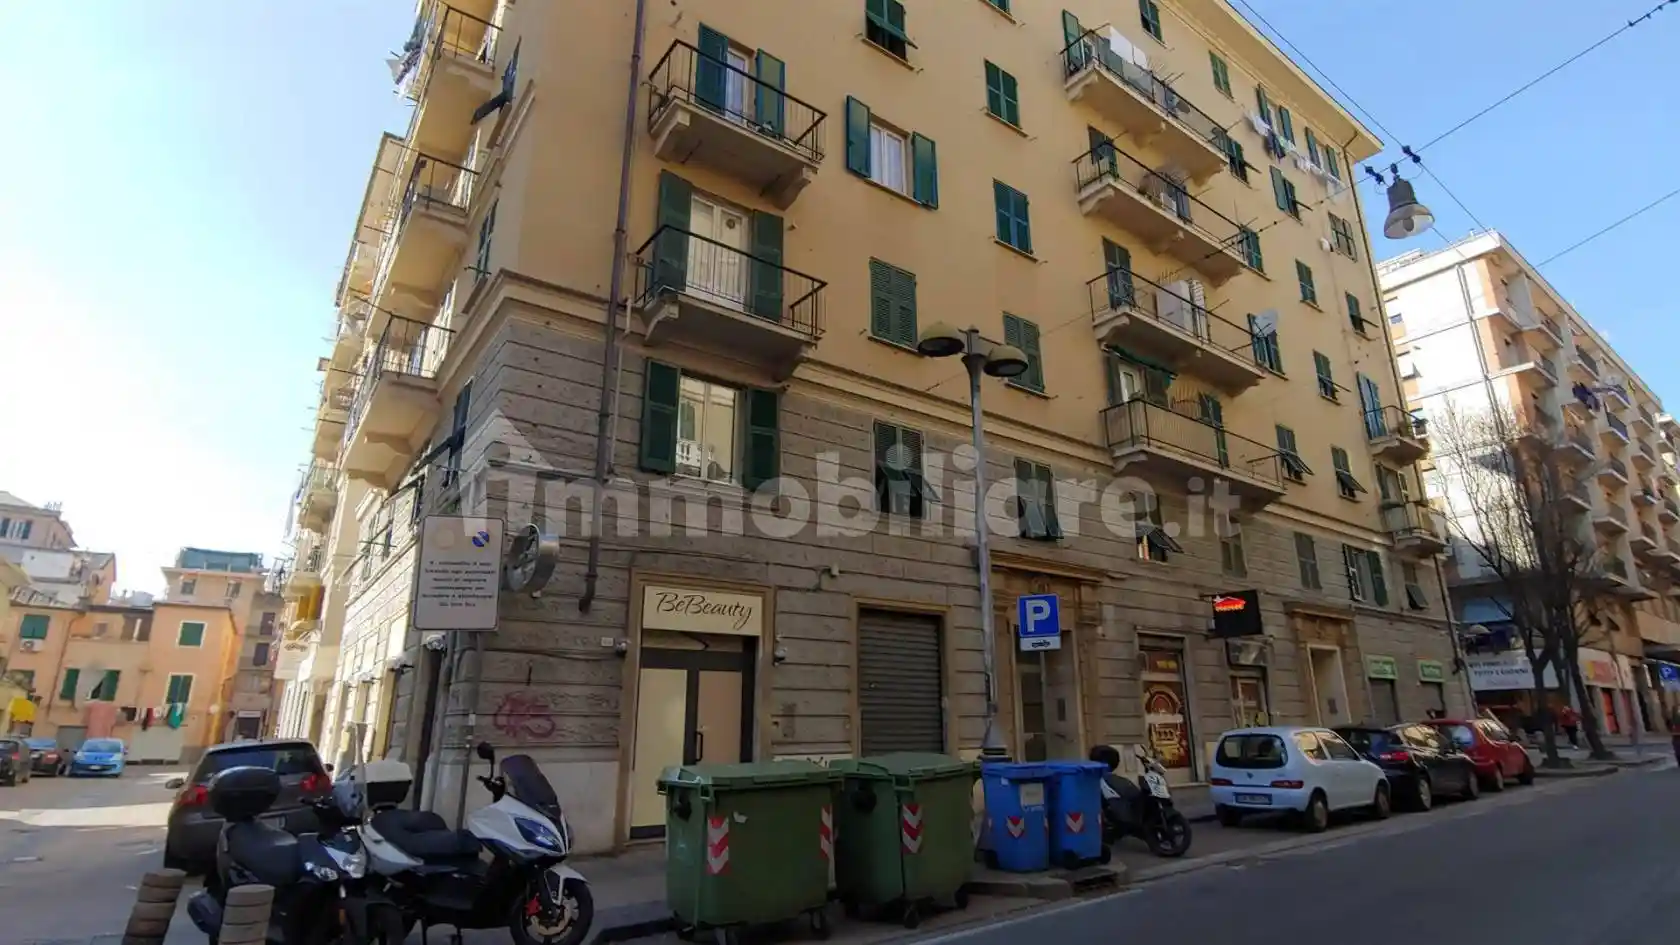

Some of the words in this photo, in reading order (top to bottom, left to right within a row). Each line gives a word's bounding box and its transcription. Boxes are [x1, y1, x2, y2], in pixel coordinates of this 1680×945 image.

[656, 591, 752, 630] BeBeauty
[1026, 599, 1050, 632] P
[1662, 667, 1672, 678] P
